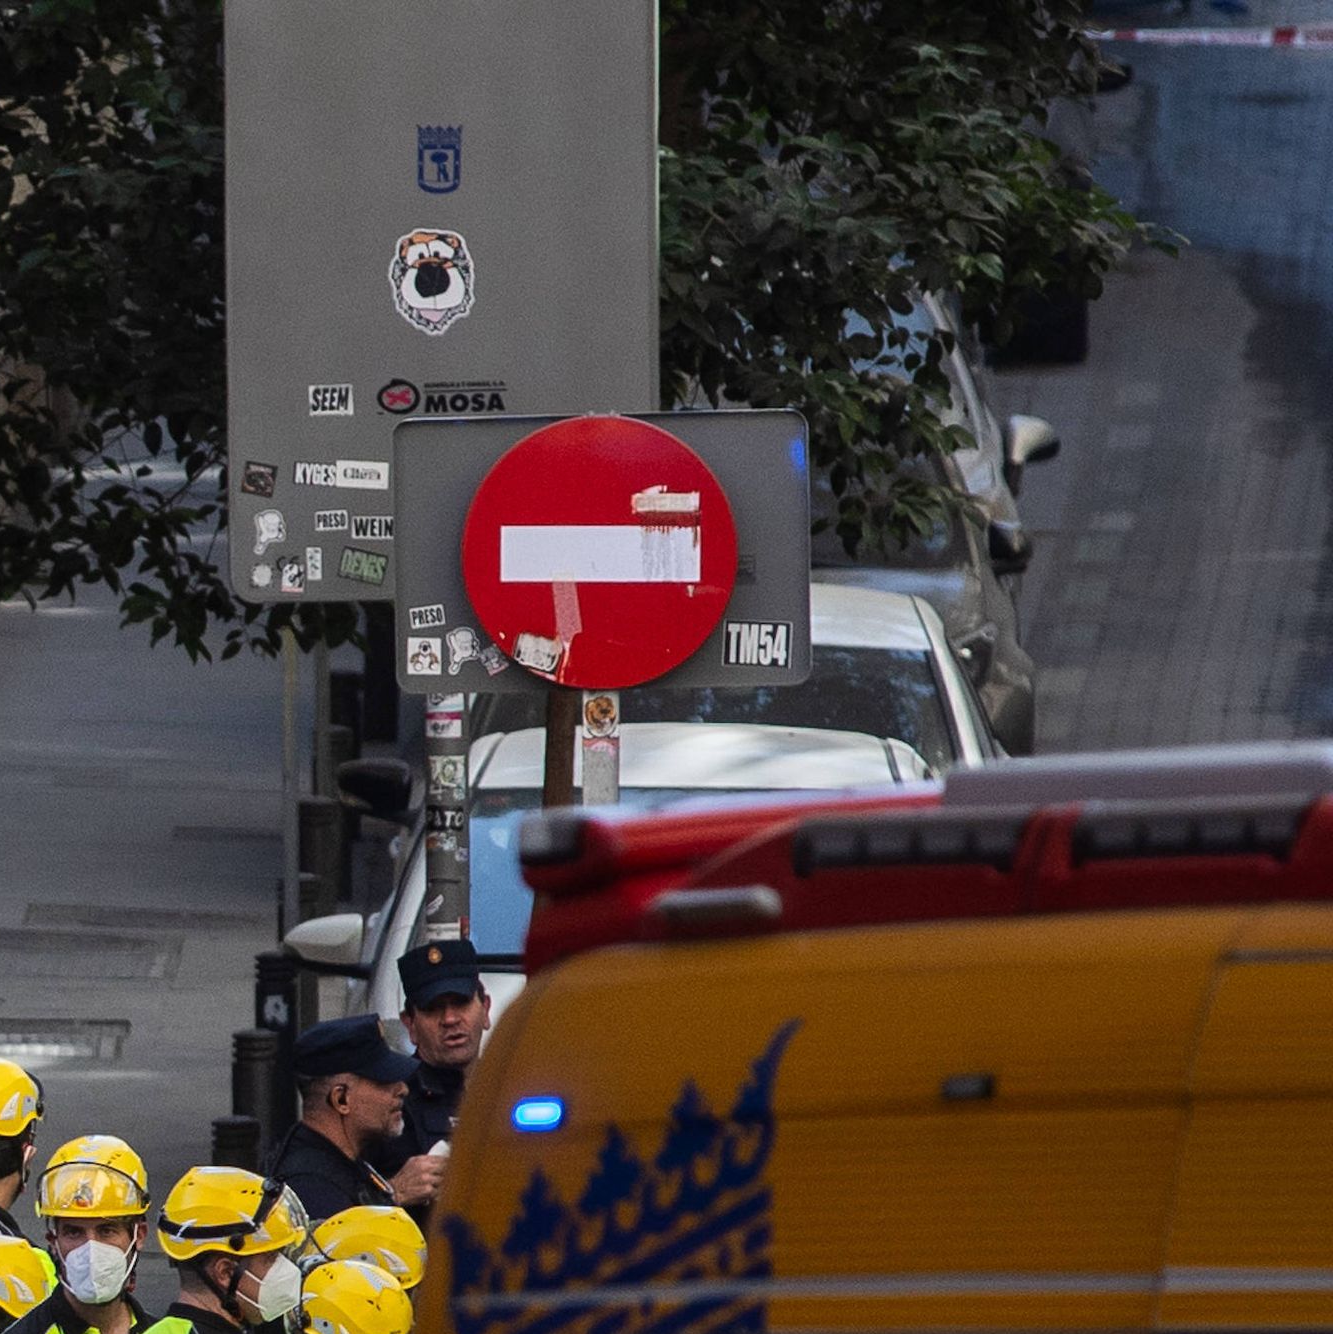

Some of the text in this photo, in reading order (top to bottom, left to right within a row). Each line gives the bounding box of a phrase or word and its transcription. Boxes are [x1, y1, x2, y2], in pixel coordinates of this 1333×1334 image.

[311, 386, 350, 412] SEEM
[425, 393, 506, 414] MOSA
[316, 513, 347, 529] PRESO
[411, 606, 444, 627] PRESO
[727, 622, 787, 666] TM54
